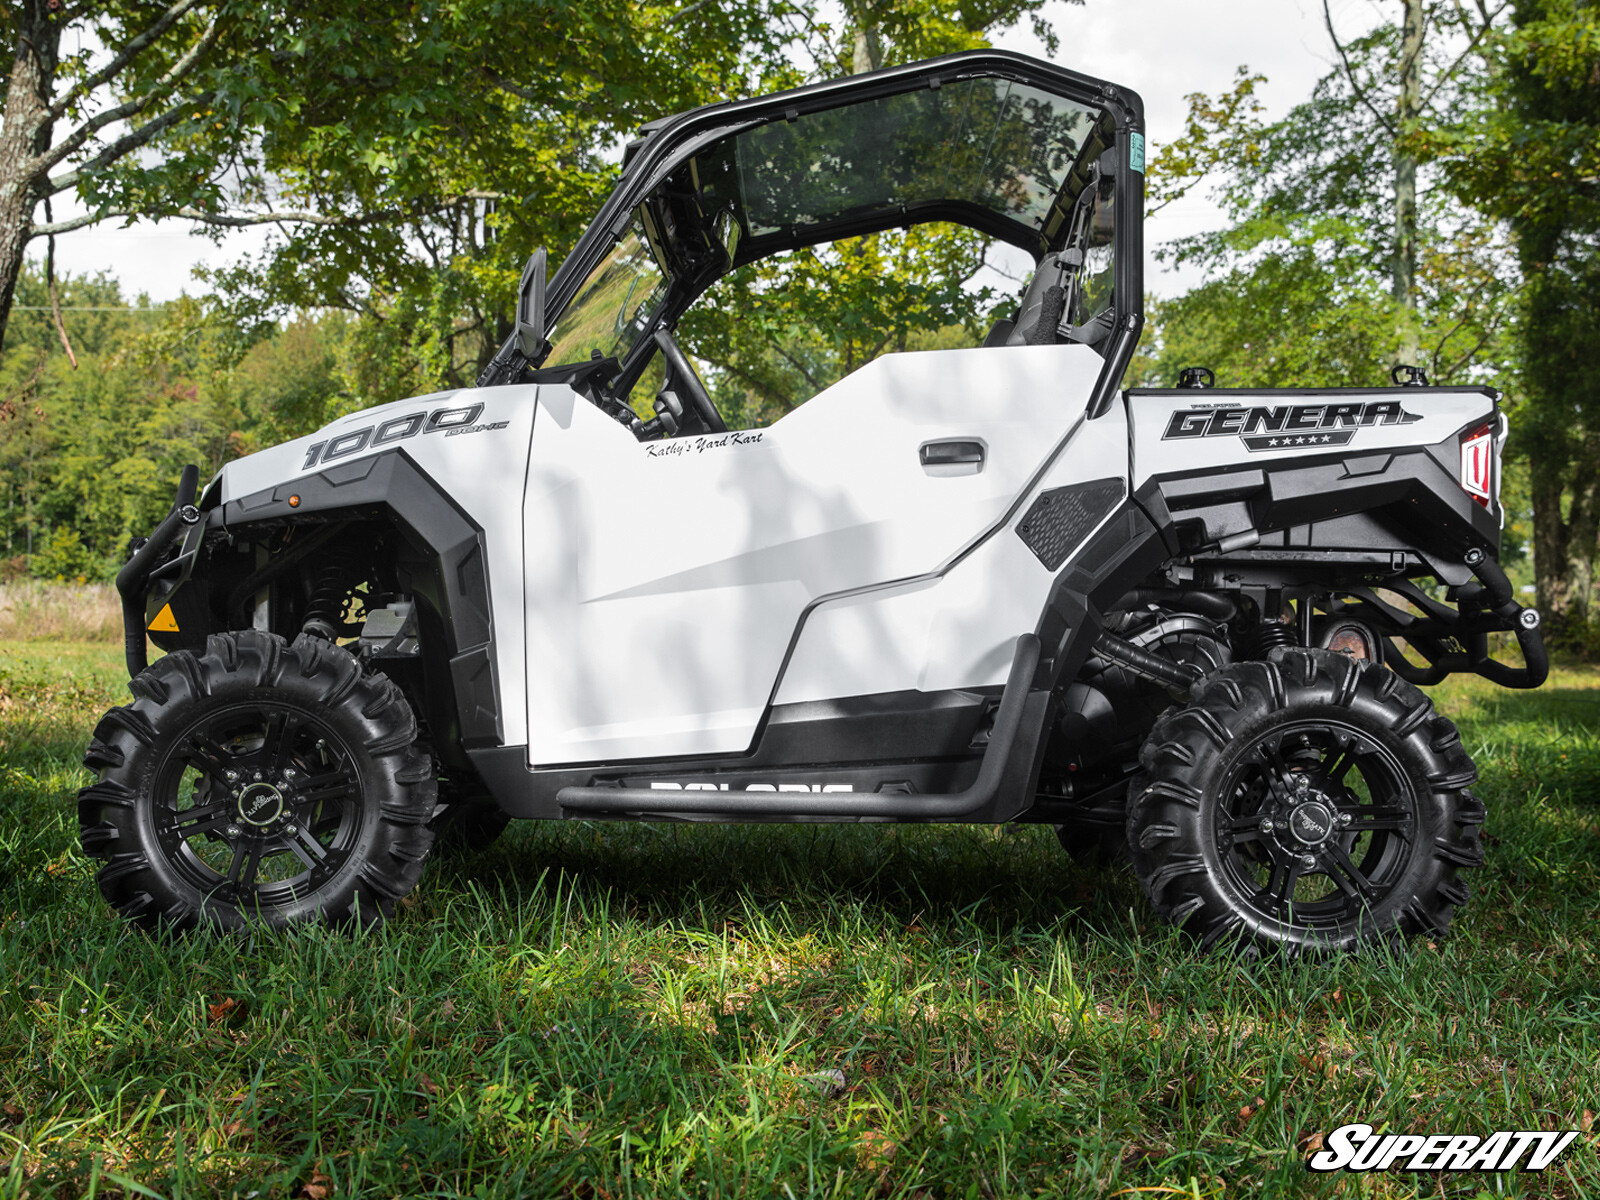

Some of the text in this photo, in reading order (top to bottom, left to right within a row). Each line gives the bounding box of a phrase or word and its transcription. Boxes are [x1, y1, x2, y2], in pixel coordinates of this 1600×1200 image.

[301, 402, 481, 470] 1000
[645, 432, 764, 457] Kathy's Yard Kart
